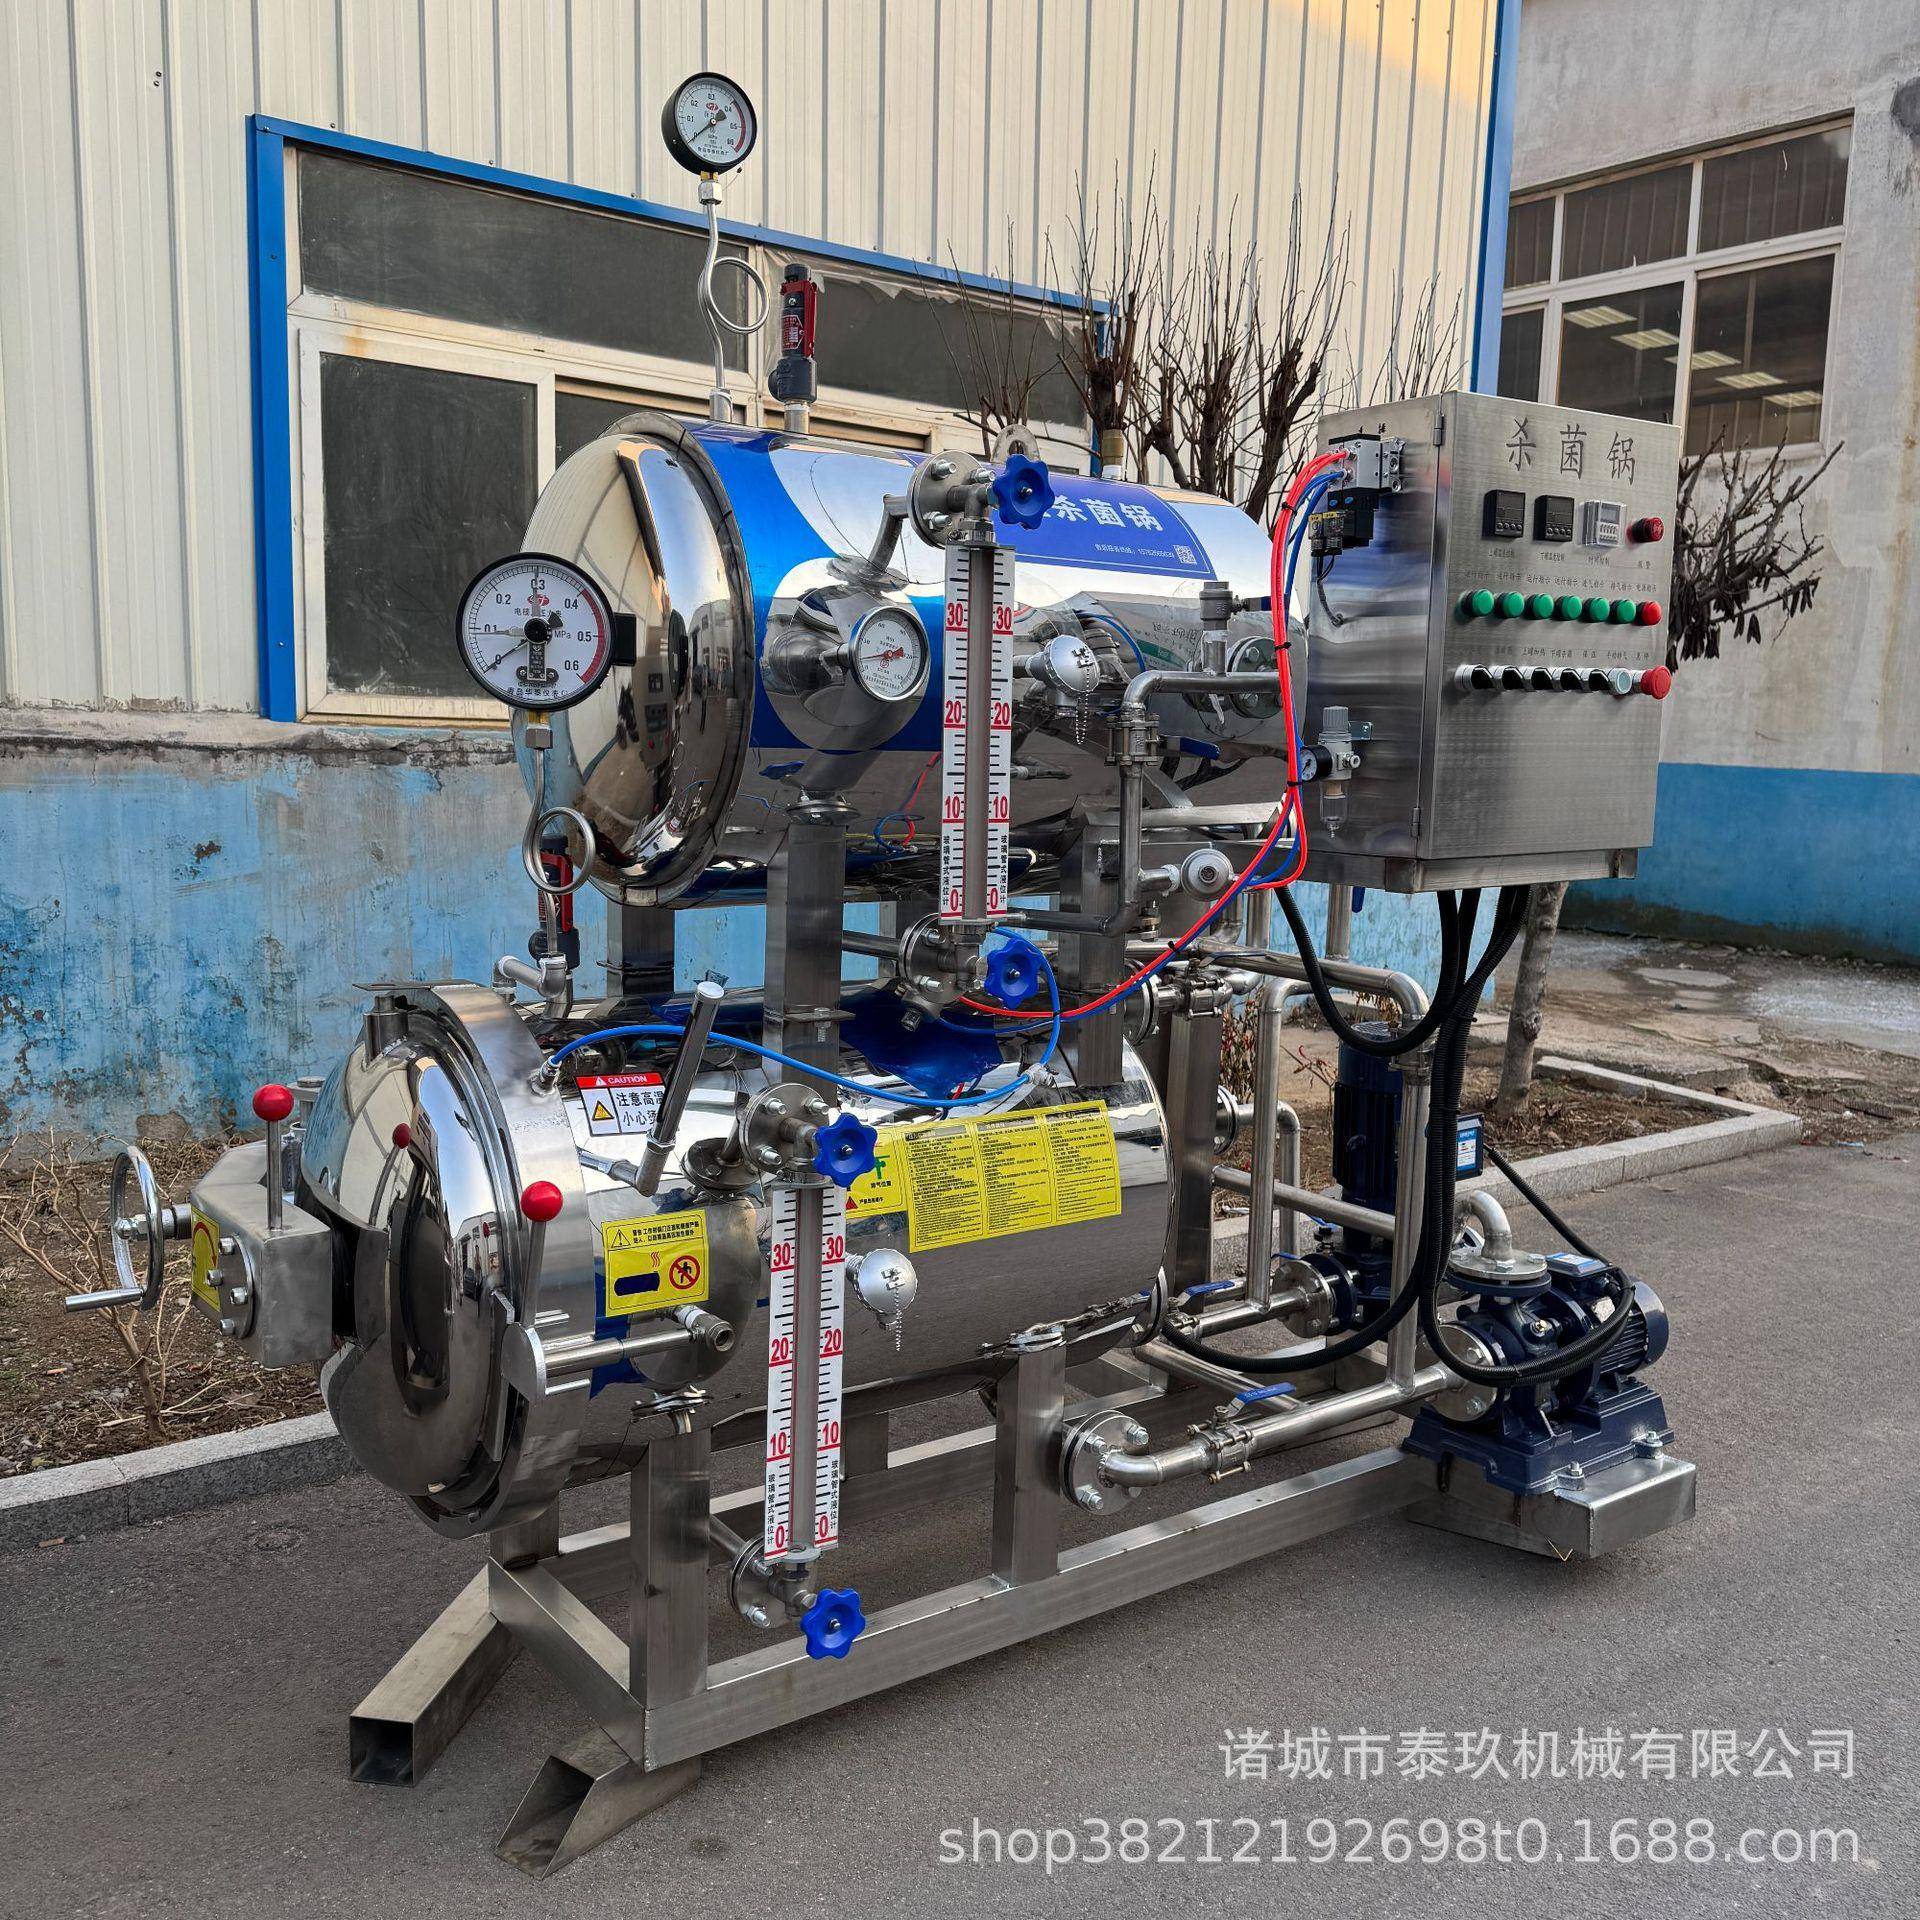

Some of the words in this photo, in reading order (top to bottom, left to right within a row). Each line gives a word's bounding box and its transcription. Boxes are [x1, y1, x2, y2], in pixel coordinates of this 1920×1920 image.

[1506, 417, 1636, 486] 杀菌锅
[1043, 494, 1164, 532] 杀菌锅
[496, 594, 511, 605] 0.2
[564, 598, 578, 610] 0.4
[947, 602, 964, 627] 30
[995, 606, 1012, 631] 30
[554, 630, 572, 640] MPa
[577, 631, 592, 642] 0.5
[564, 660, 579, 671] 0.6
[945, 700, 962, 724] 20
[993, 702, 1010, 726] 20
[945, 795, 960, 819] 10
[993, 795, 1008, 819] 10
[950, 888, 959, 912] 0
[990, 887, 998, 910] 0
[608, 1075, 647, 1085] CAUTION
[773, 1242, 791, 1267] 30
[826, 1235, 844, 1260] 30
[770, 1337, 789, 1362] 20
[823, 1328, 842, 1353] 20
[770, 1432, 787, 1456] 10
[822, 1421, 839, 1445] 10
[775, 1525, 784, 1549] 0
[818, 1515, 828, 1538] 0
